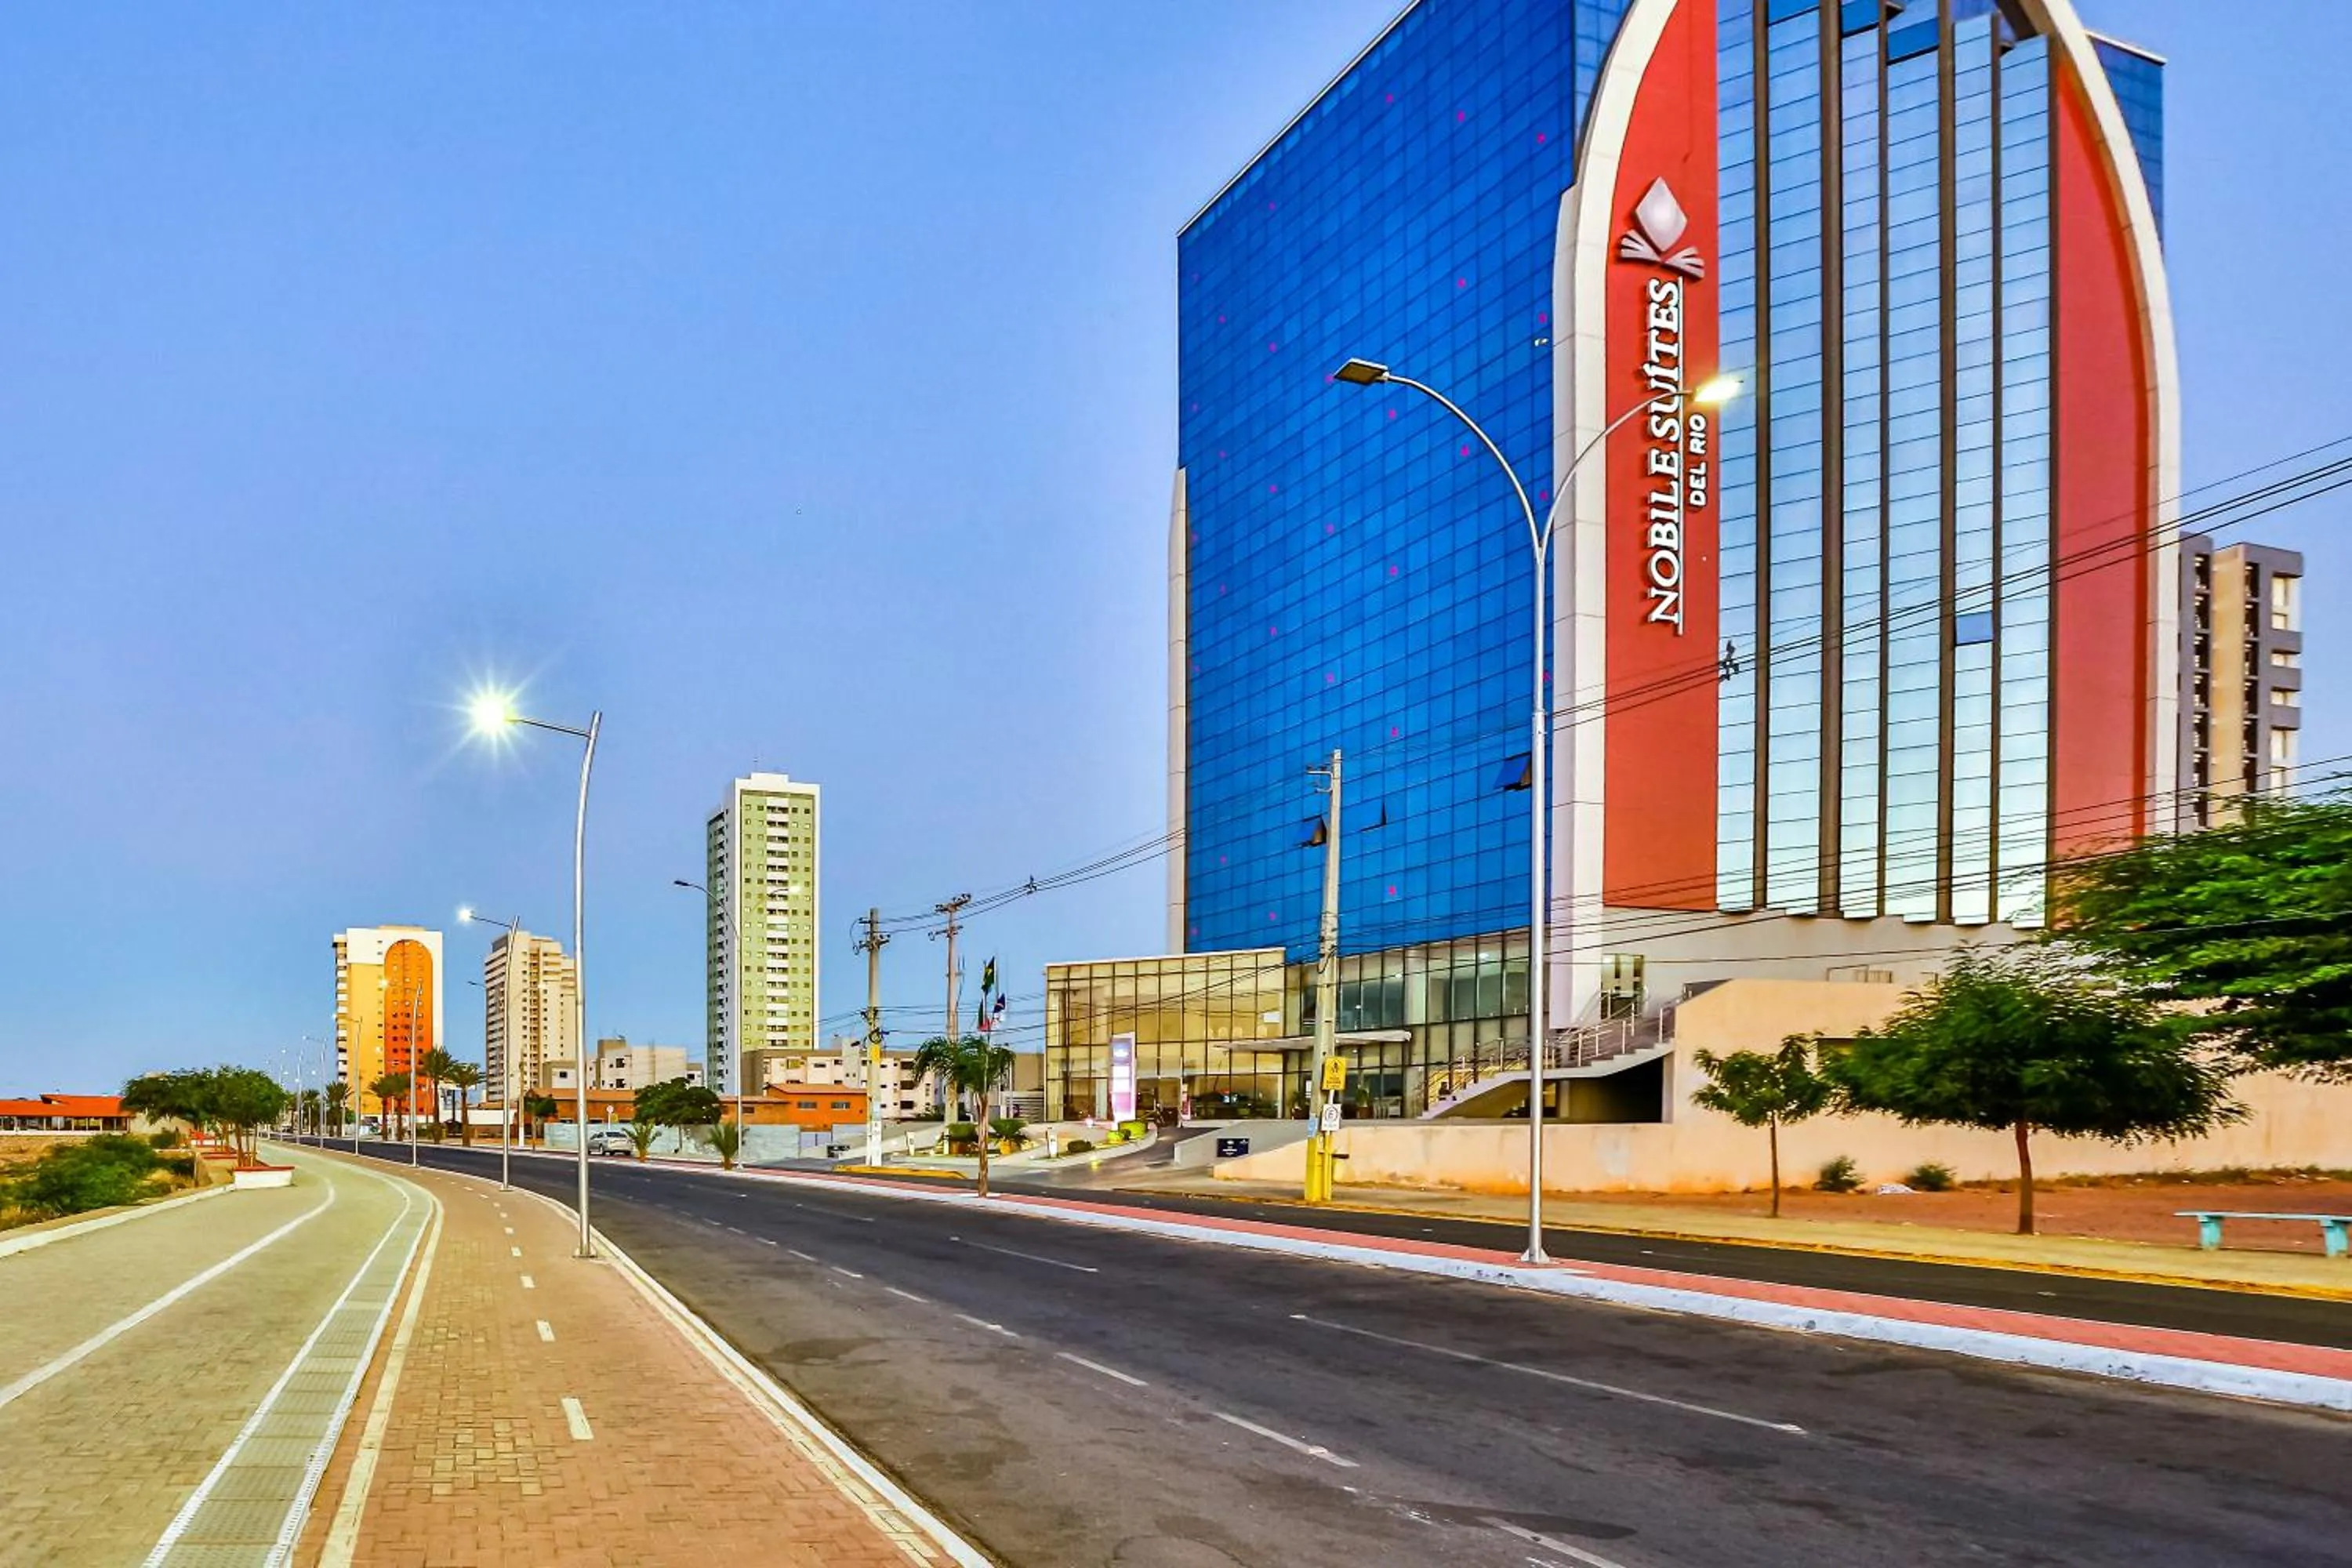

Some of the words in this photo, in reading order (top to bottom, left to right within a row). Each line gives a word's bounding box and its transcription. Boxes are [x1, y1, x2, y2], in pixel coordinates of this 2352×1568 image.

[1642, 278, 1680, 443] SUÍTES
[1688, 412, 1707, 455] RIO
[1689, 461, 1707, 506] DEL
[1649, 448, 1680, 624] NOBILE
